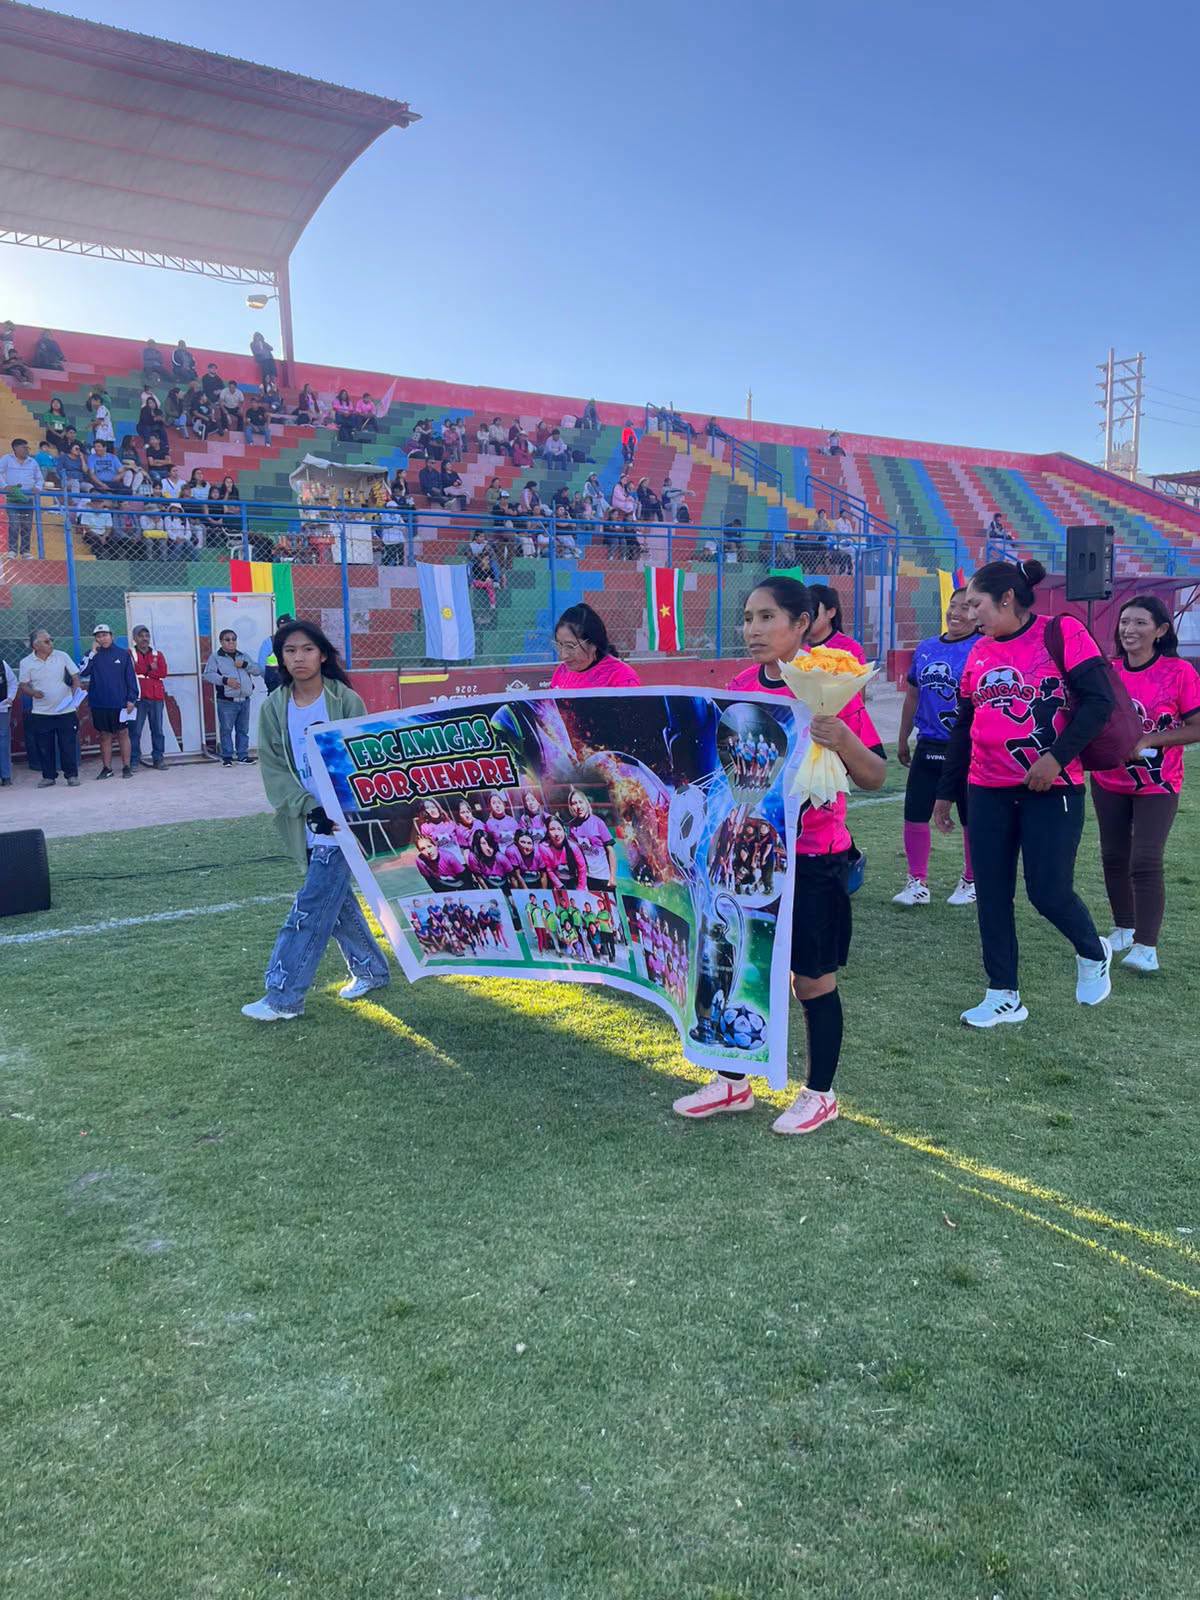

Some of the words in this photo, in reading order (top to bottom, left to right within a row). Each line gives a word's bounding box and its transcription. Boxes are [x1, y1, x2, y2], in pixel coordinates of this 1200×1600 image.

[973, 683, 1034, 705] AMIGAS
[350, 735, 402, 767] FBC
[400, 718, 492, 759] AMIGAS
[353, 771, 413, 804] POR
[409, 756, 514, 793] SIEMPRE
